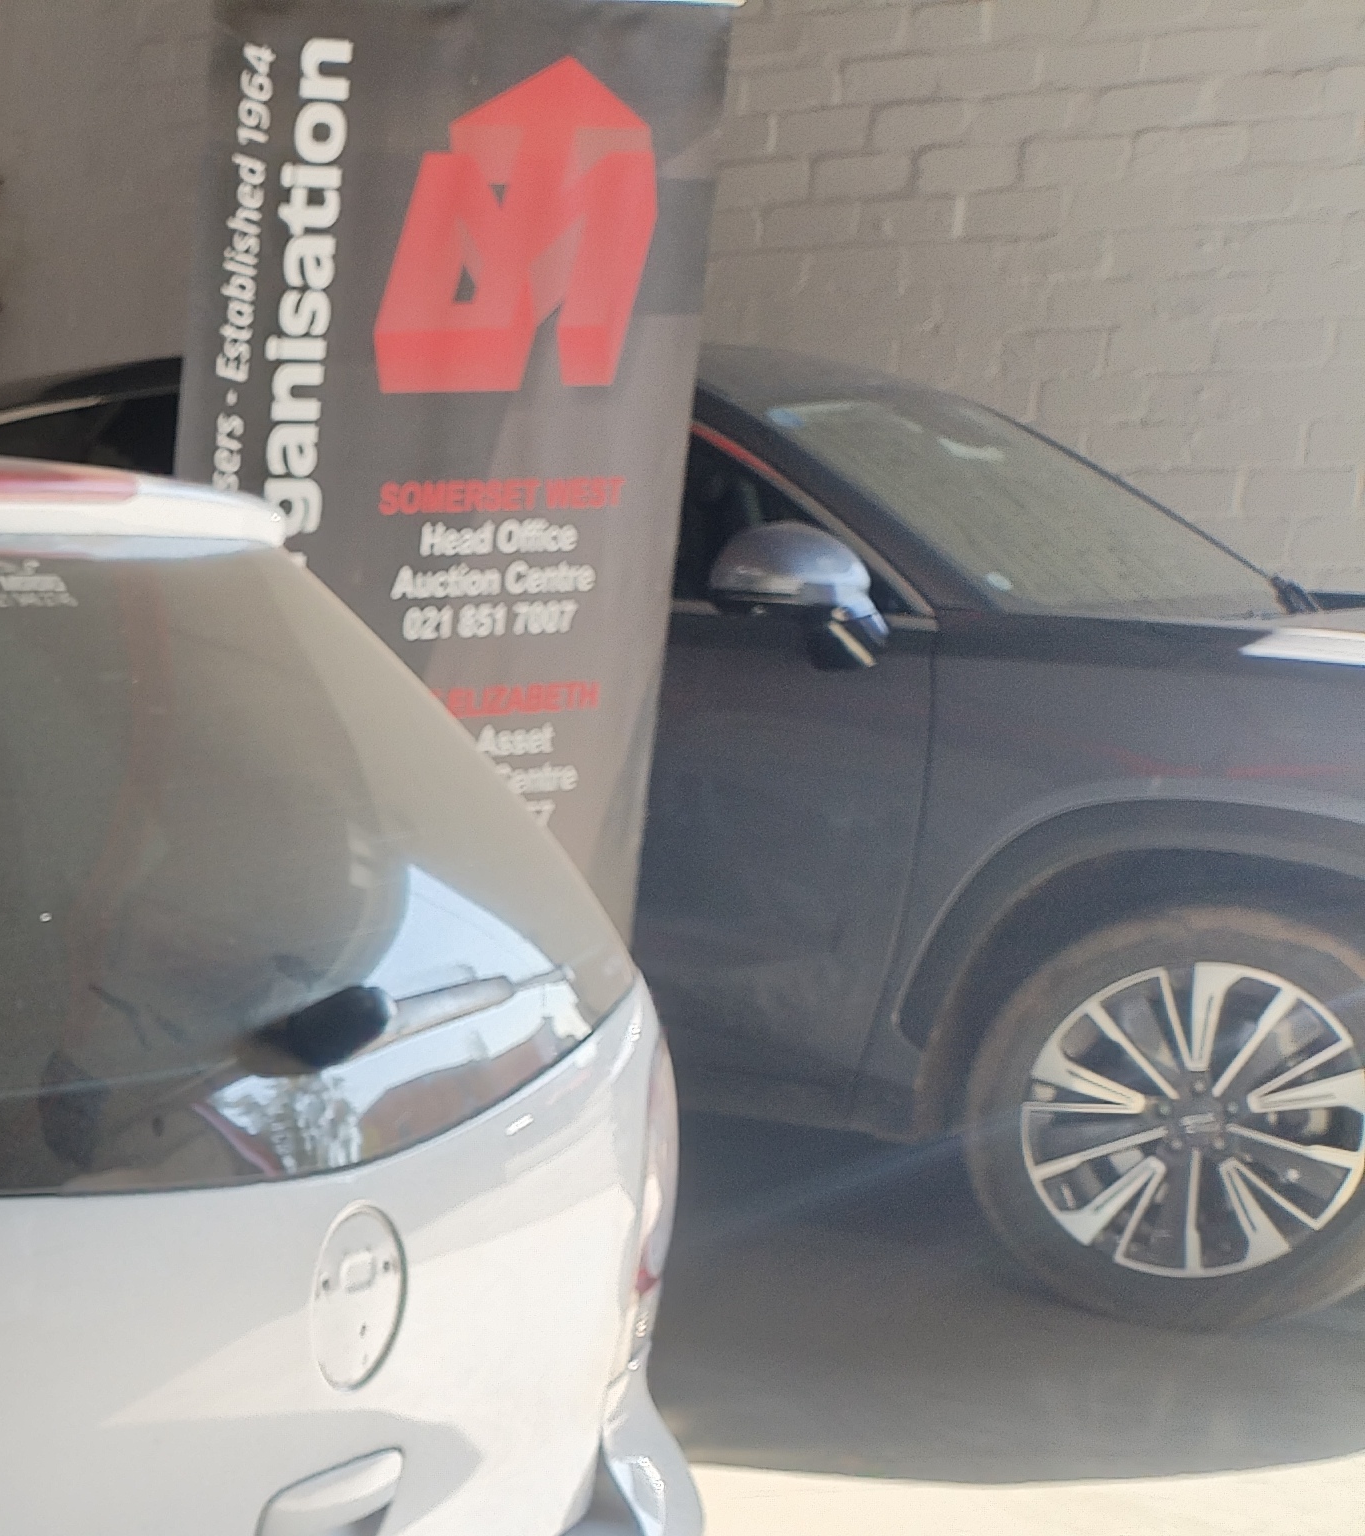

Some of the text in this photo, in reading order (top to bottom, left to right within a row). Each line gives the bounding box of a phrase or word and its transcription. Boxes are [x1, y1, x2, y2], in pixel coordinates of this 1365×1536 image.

[236, 41, 277, 147] 1964
[215, 152, 267, 384] Established
[262, 36, 355, 570] ganisation
[378, 476, 626, 516] SOMERSET WEST
[419, 517, 579, 557] Head Office
[389, 559, 597, 600] Auction Centre
[402, 599, 579, 641] 021 851 7007
[445, 680, 601, 719] ELIZABETH
[475, 721, 556, 756] Asset
